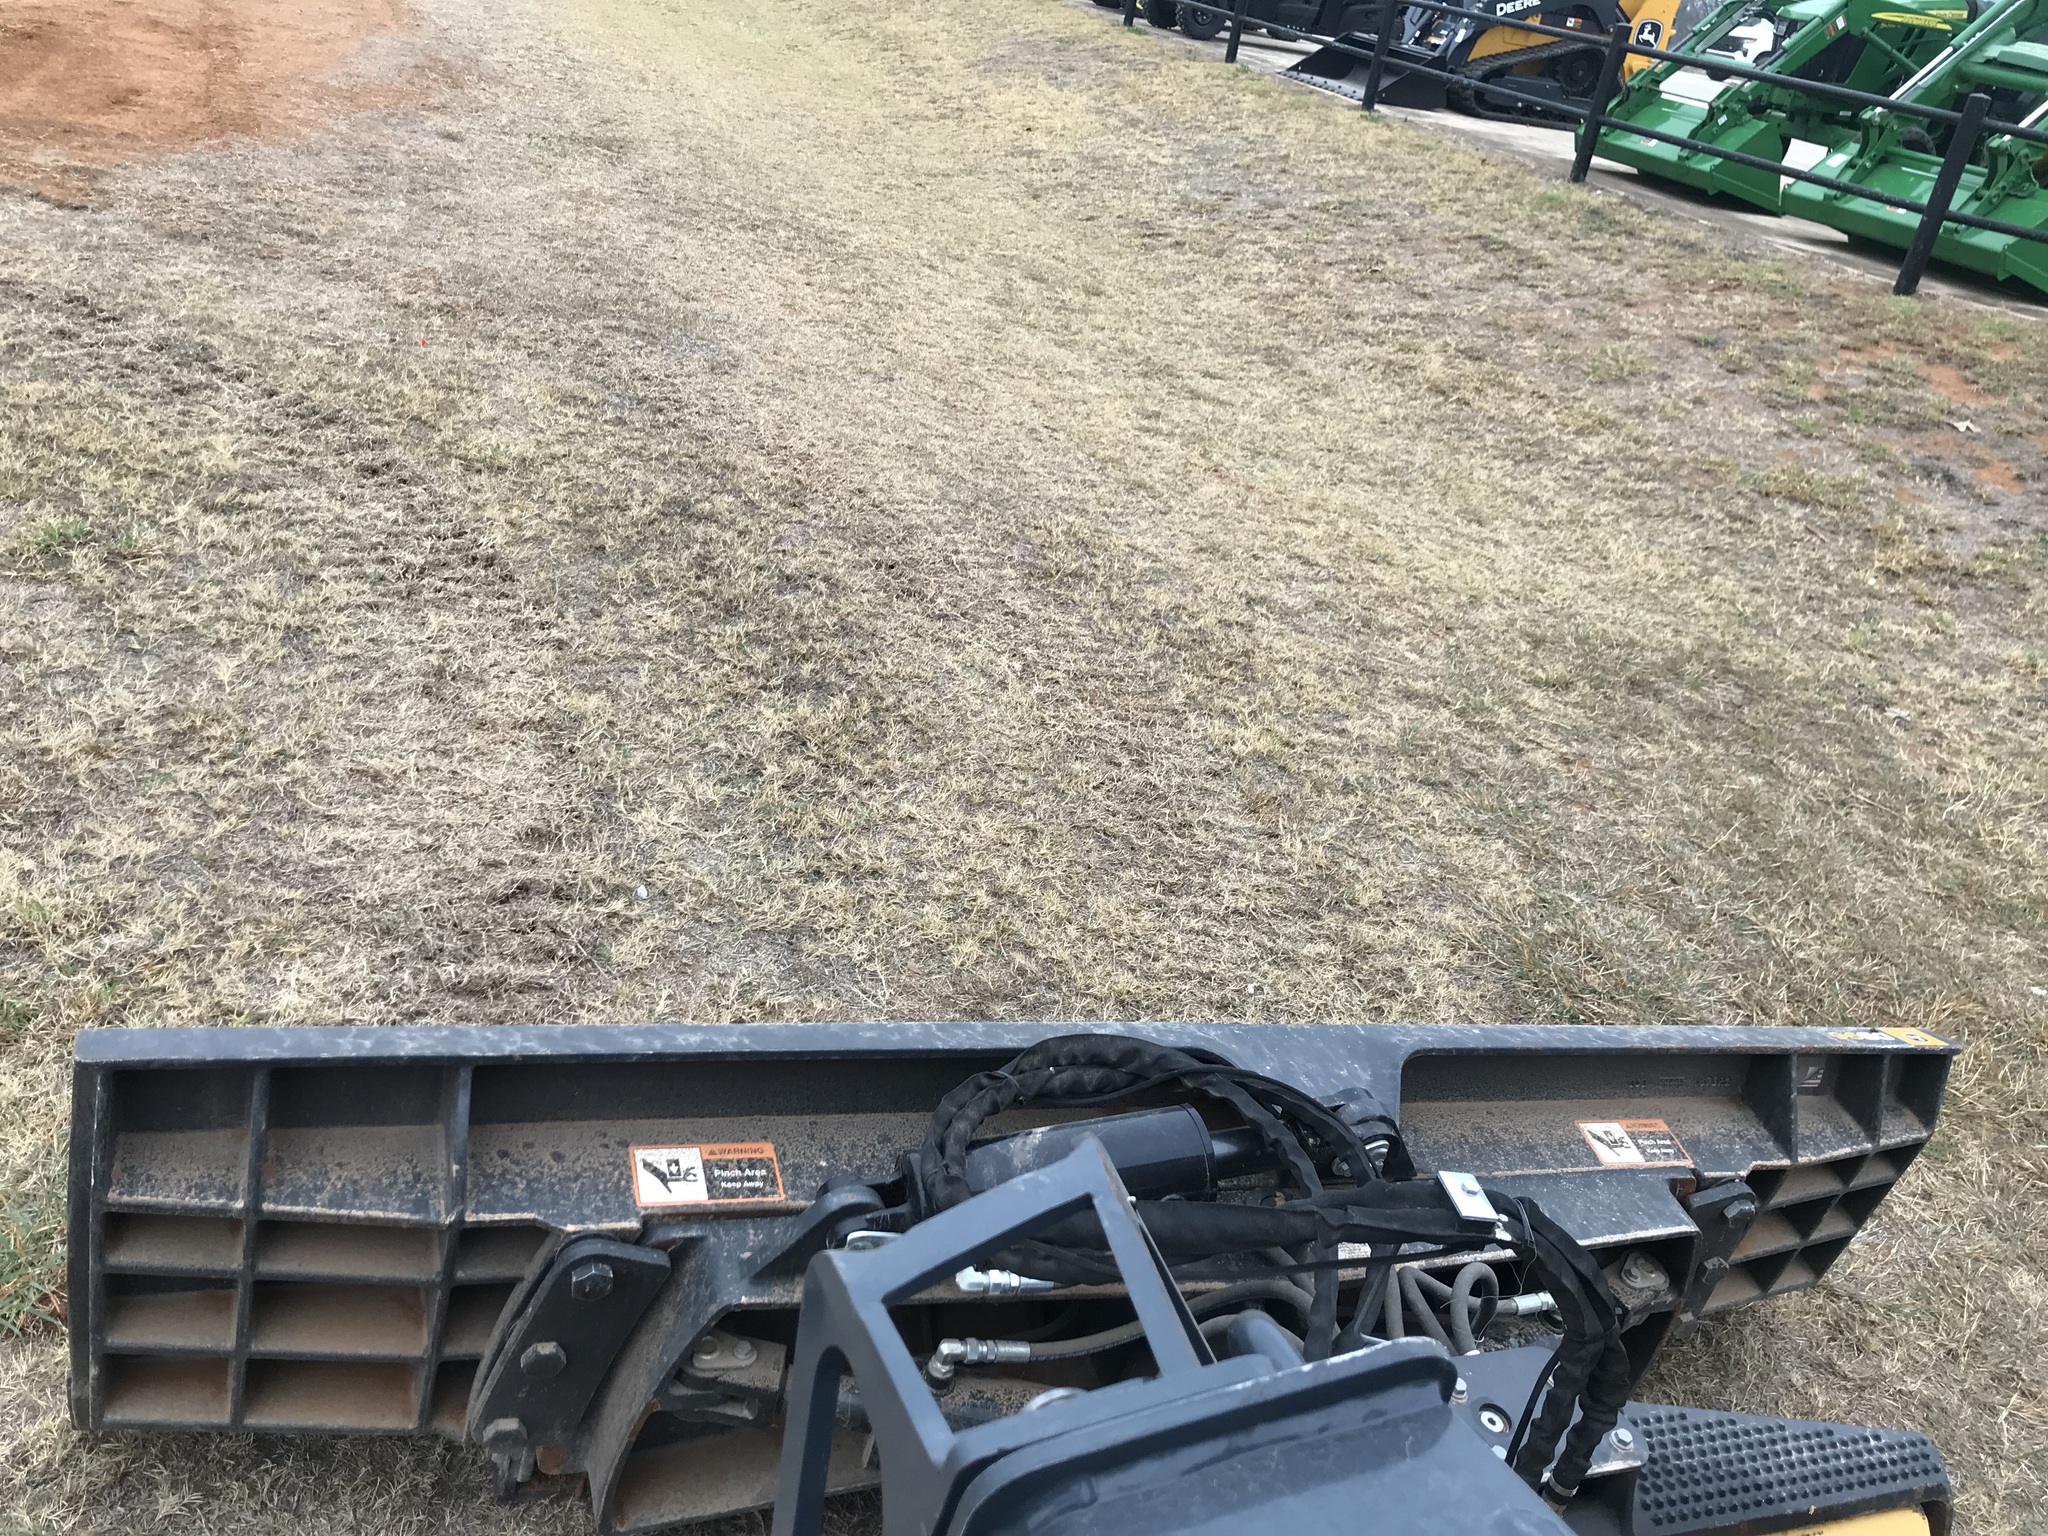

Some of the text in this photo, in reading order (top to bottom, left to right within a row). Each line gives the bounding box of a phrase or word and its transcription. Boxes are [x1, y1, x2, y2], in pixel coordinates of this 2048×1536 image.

[718, 1147, 764, 1155] WARNING
[714, 1168, 767, 1177] Pinch Area
